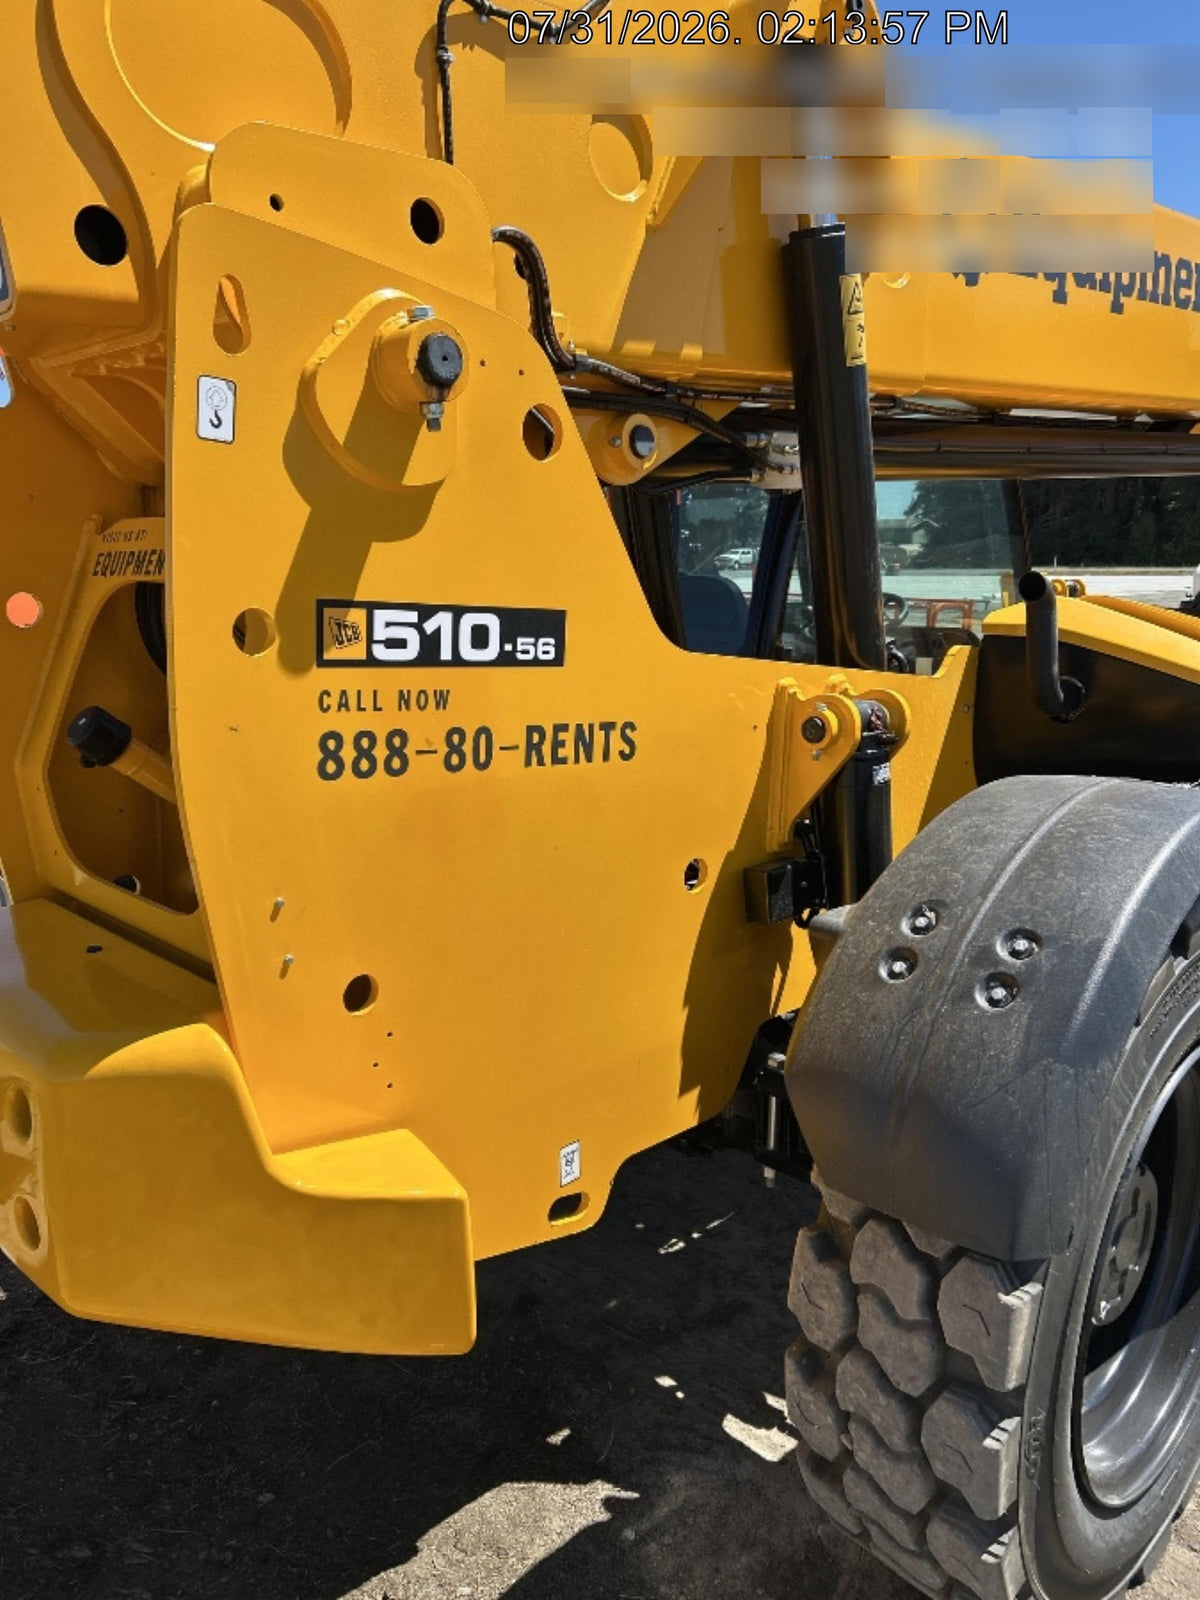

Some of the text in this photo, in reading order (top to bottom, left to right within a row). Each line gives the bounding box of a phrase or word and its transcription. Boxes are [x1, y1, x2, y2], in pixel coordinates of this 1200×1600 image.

[333, 620, 360, 647] JCB
[317, 689, 450, 713] CALL NOW
[317, 721, 637, 781] 888-80-RENTS
